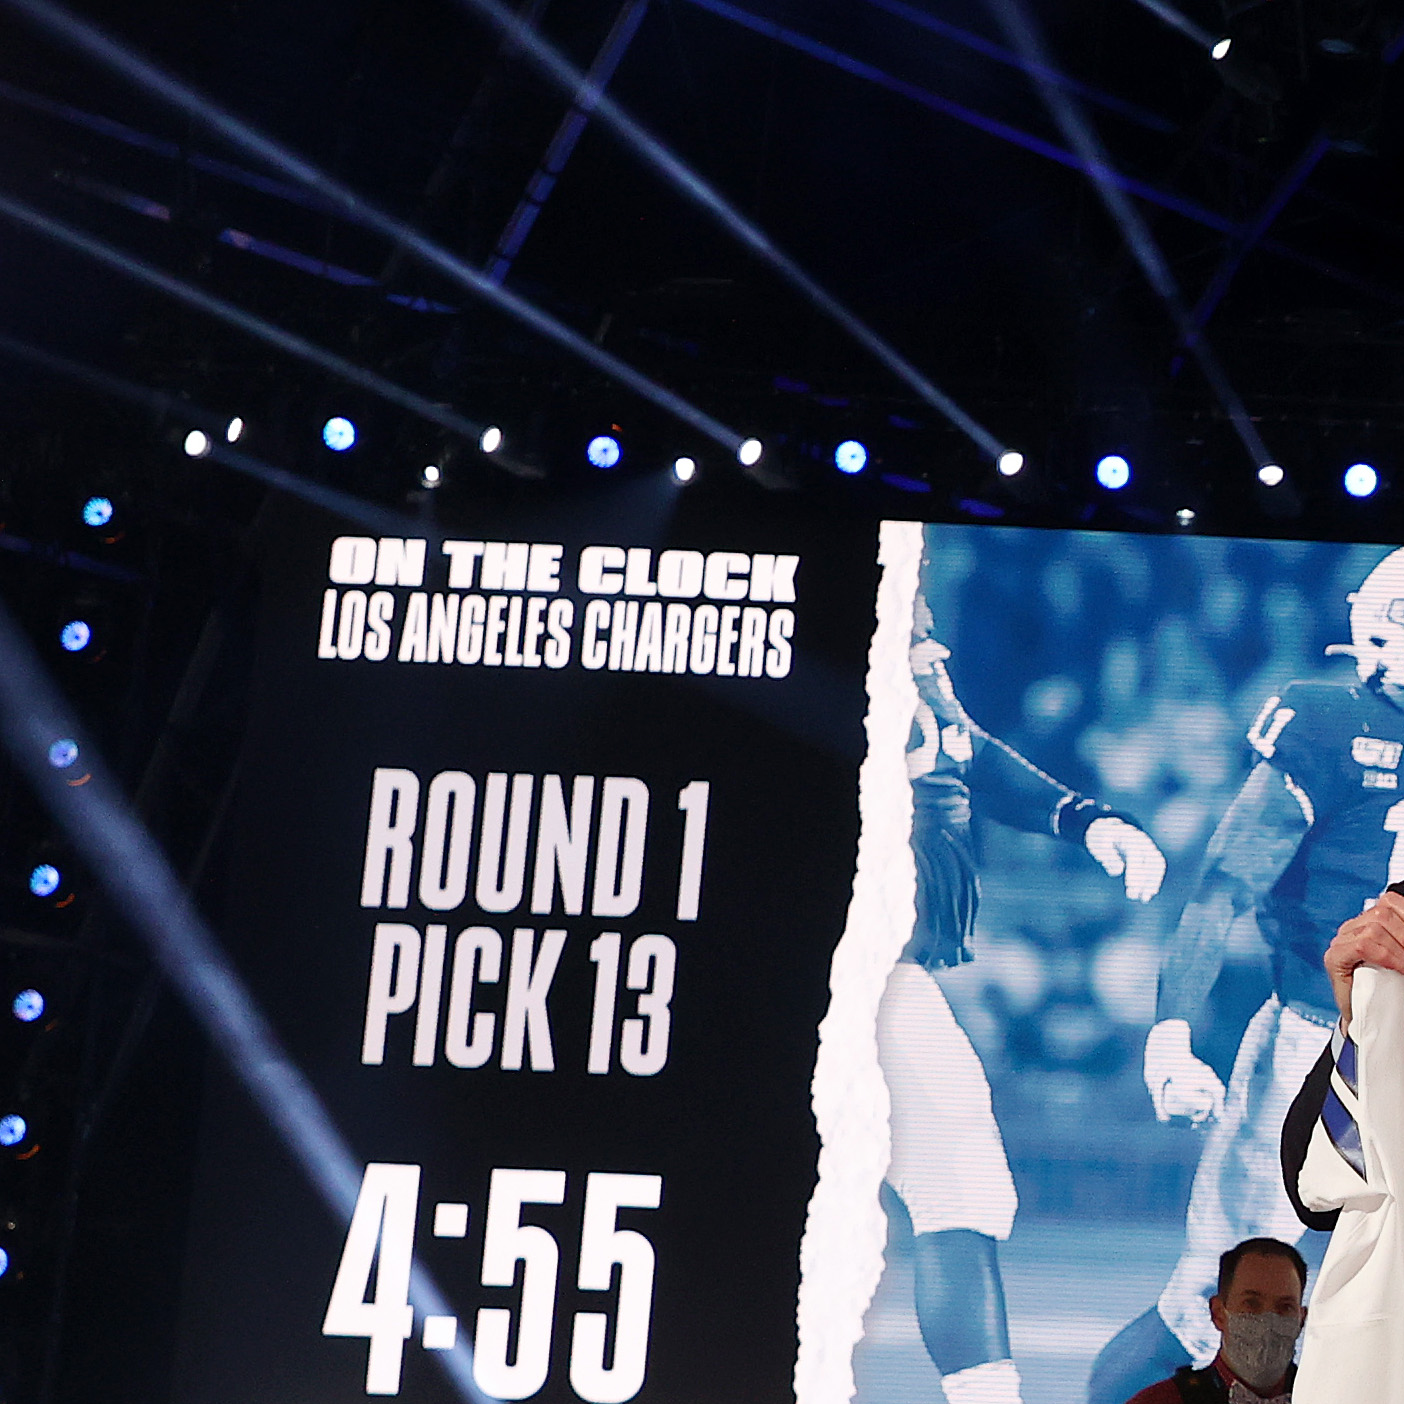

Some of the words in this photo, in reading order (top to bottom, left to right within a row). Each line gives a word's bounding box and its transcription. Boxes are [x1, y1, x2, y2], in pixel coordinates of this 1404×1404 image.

[318, 588, 395, 661] LOS
[398, 590, 574, 669] ANGELES
[582, 598, 796, 679] CHARGERS
[326, 536, 426, 588] ON
[442, 540, 563, 592] THE
[577, 546, 800, 603] CLOCK
[361, 768, 649, 916] ROUND
[677, 781, 709, 920] 1
[362, 923, 567, 1071] PICK
[588, 933, 676, 1075] 13
[322, 1162, 662, 1404] 4:55
